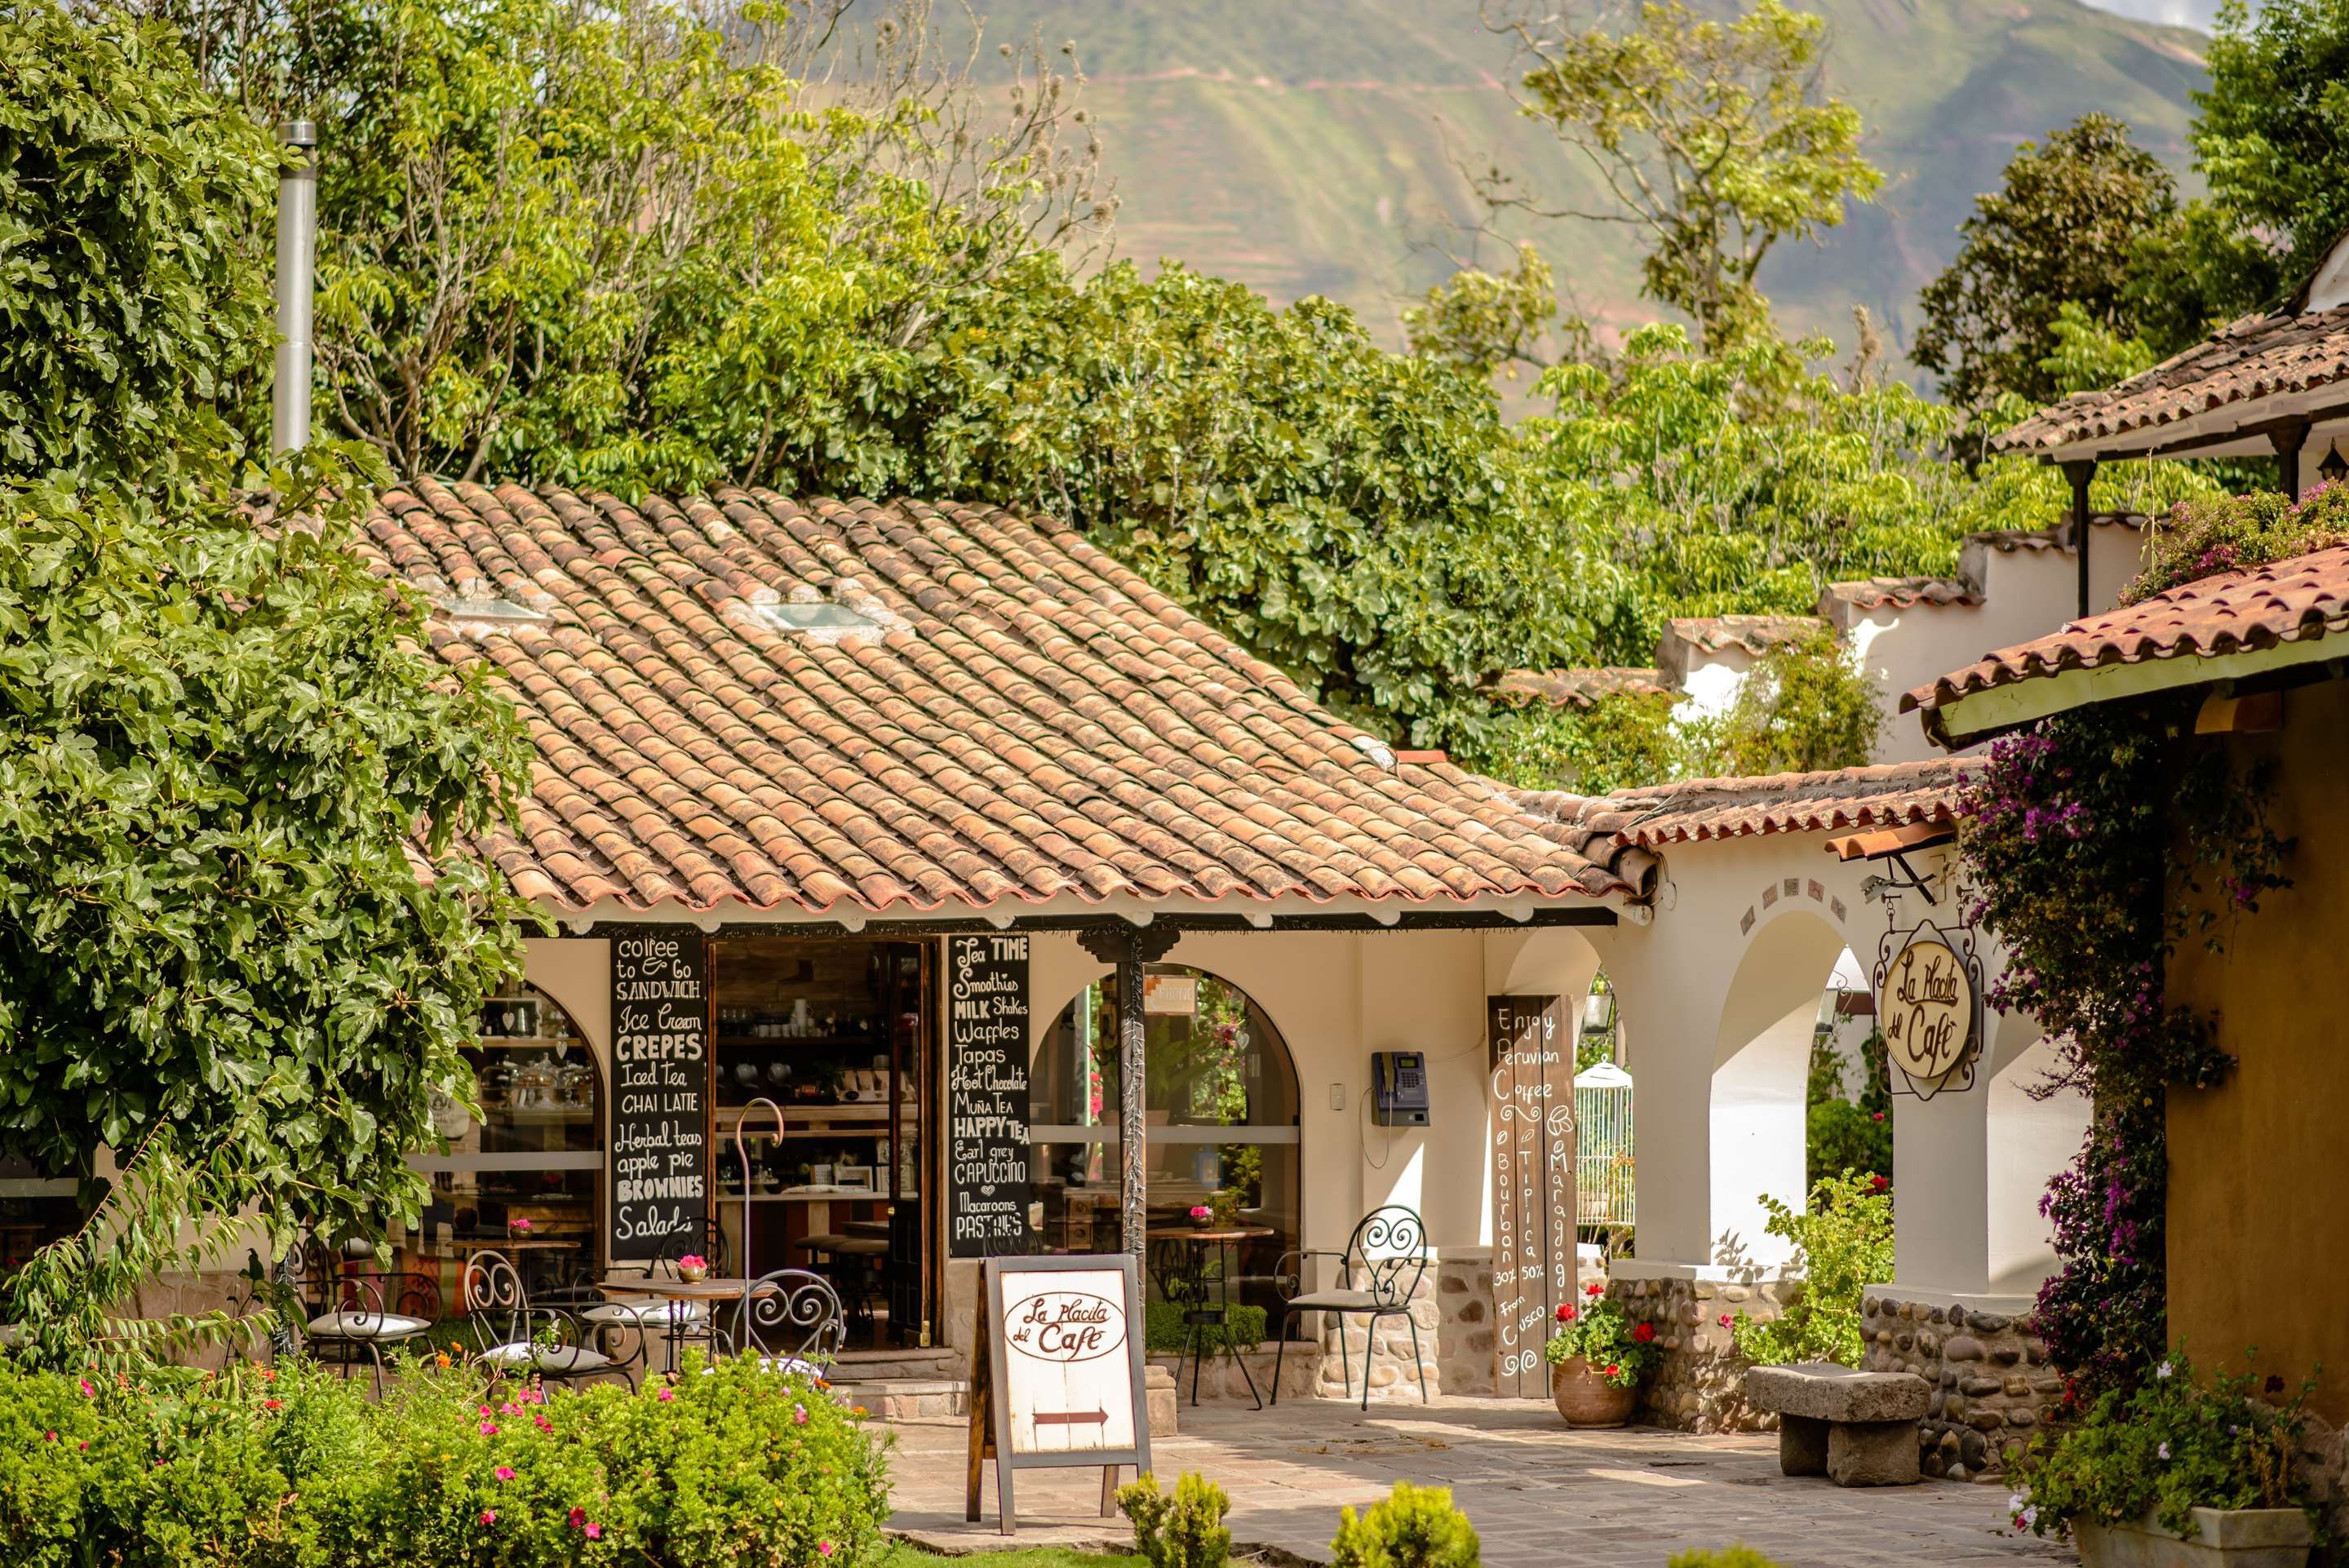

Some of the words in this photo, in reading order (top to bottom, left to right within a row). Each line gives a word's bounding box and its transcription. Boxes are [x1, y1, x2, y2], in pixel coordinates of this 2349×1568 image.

[956, 937, 986, 968] Tea
[991, 937, 1027, 960] TIME
[617, 960, 635, 978] to
[673, 959, 691, 978] Go
[1897, 949, 1916, 1003] La
[617, 981, 700, 1000] SANDWICH
[953, 966, 1018, 1000] Smoothies
[618, 1005, 649, 1034] Ice
[658, 1003, 702, 1030] Cream
[955, 1000, 990, 1019] MILK
[955, 1018, 1019, 1044] Waffles
[1498, 1008, 1555, 1039] Enjoy
[617, 1034, 702, 1061] CREPES
[955, 1044, 1005, 1070] Tapas
[1496, 1038, 1559, 1065] Peruvian
[621, 1061, 658, 1087] Iced
[661, 1061, 687, 1086] Tea
[951, 1064, 984, 1091] Hot
[985, 1065, 1026, 1091] Chocolate
[1494, 1070, 1553, 1104] Coffee
[622, 1094, 657, 1113] CHAI
[664, 1093, 698, 1112] LATTE
[615, 1121, 672, 1153] Herbal
[673, 1120, 702, 1146] teas
[954, 1116, 1008, 1137] HAPPY
[1006, 1120, 1030, 1145] TEA
[618, 1149, 659, 1180] apple
[668, 1151, 694, 1176] pie
[955, 1139, 984, 1161] Earl
[990, 1147, 1014, 1165] grey
[618, 1175, 703, 1203] BROWNIES
[960, 1191, 1017, 1213] Macaroons
[1494, 1268, 1517, 1286] 30%
[1522, 1264, 1544, 1280] 50%
[1023, 1297, 1048, 1323] La
[1057, 1298, 1109, 1322] Placita
[1500, 1296, 1526, 1316] From
[1013, 1326, 1031, 1343] del
